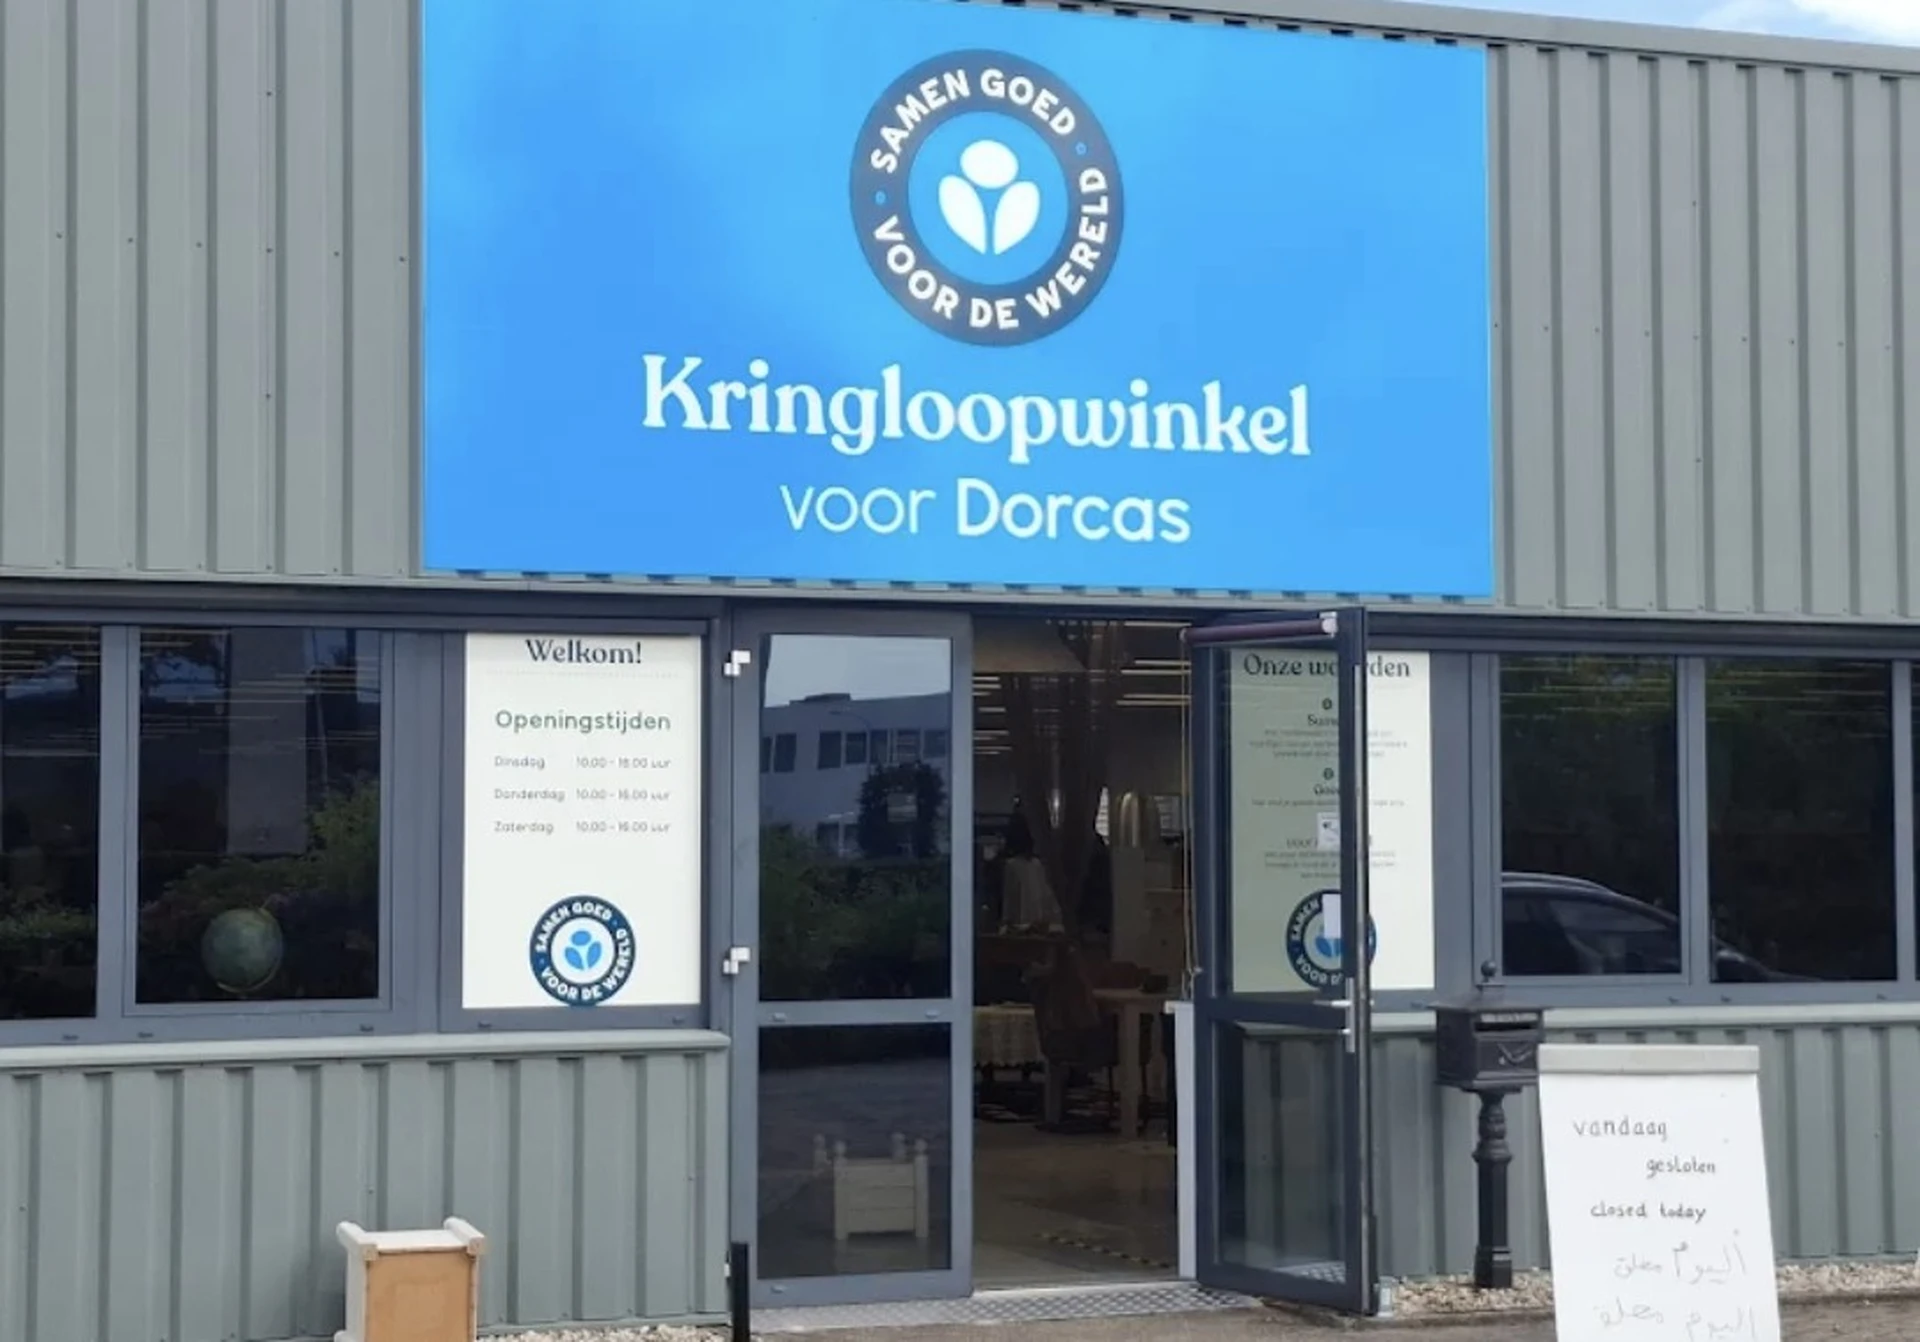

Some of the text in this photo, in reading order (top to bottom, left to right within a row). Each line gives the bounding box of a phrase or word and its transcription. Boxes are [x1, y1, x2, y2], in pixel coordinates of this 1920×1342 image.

[870, 68, 1077, 174] SAMEN GOED
[873, 166, 1109, 330] VOOR DE WERELD
[641, 354, 1312, 465] Kringloopwinkel
[779, 477, 1192, 544] voor Dorcas
[525, 638, 642, 664] Welkom!
[1244, 653, 1303, 677] Onze
[494, 708, 672, 735] Openingstijden
[494, 755, 545, 771] Dinsdag
[494, 788, 566, 804] Donderdag
[494, 821, 554, 838] Zaterdag
[535, 901, 612, 953] SAMEN GOED
[541, 966, 579, 1000] VOOR
[581, 985, 602, 1001] DE
[1573, 1115, 1668, 1142] vandaag
[1646, 1155, 1716, 1179] gesloten
[1590, 1202, 1706, 1224] closed today
